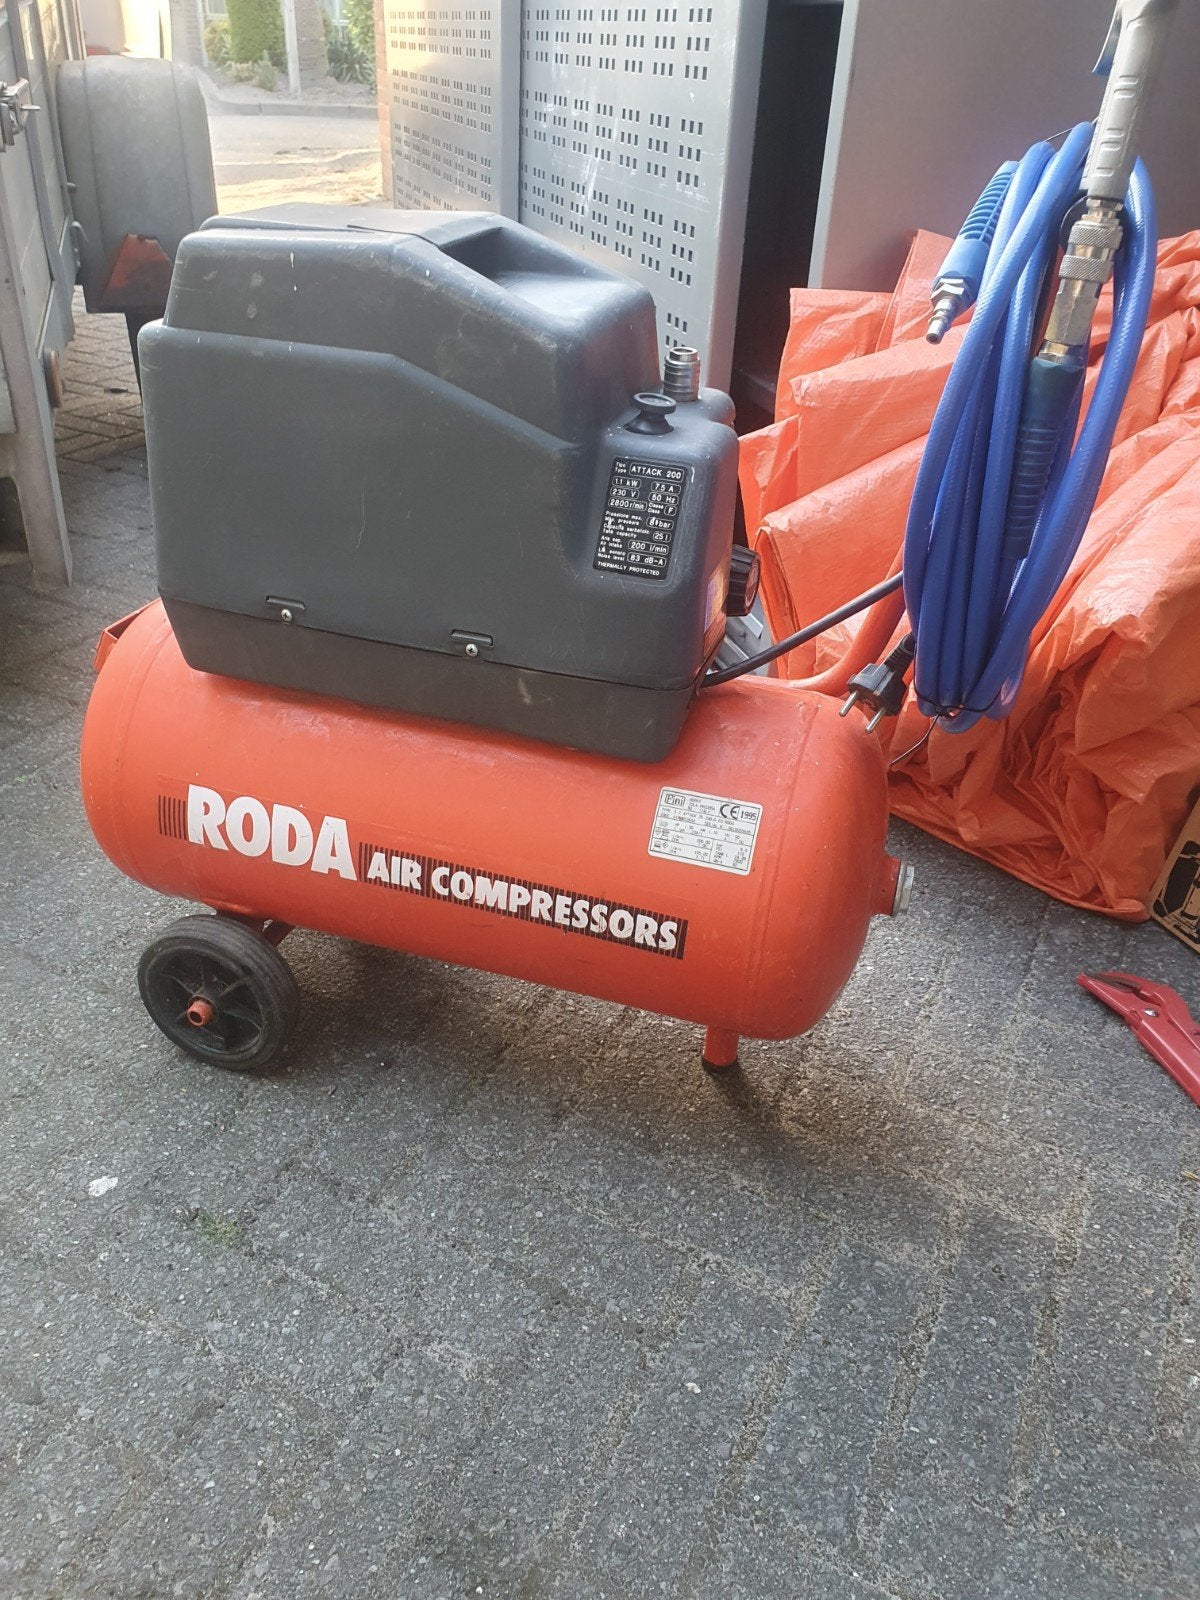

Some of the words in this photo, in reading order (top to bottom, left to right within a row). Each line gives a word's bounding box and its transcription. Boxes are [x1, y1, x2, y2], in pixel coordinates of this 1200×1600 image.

[631, 466, 662, 476] ATTACK
[666, 471, 681, 479] 200
[612, 488, 626, 496] 230
[631, 541, 646, 550] 200
[597, 561, 627, 570] THERMALLY
[629, 566, 660, 576] PROTECTED
[666, 794, 686, 807] Fini
[720, 804, 740, 820] CE
[740, 810, 758, 821] 1995
[188, 784, 357, 881] RODA
[367, 852, 422, 890] AIR
[431, 866, 679, 951] COMPRESSORS
